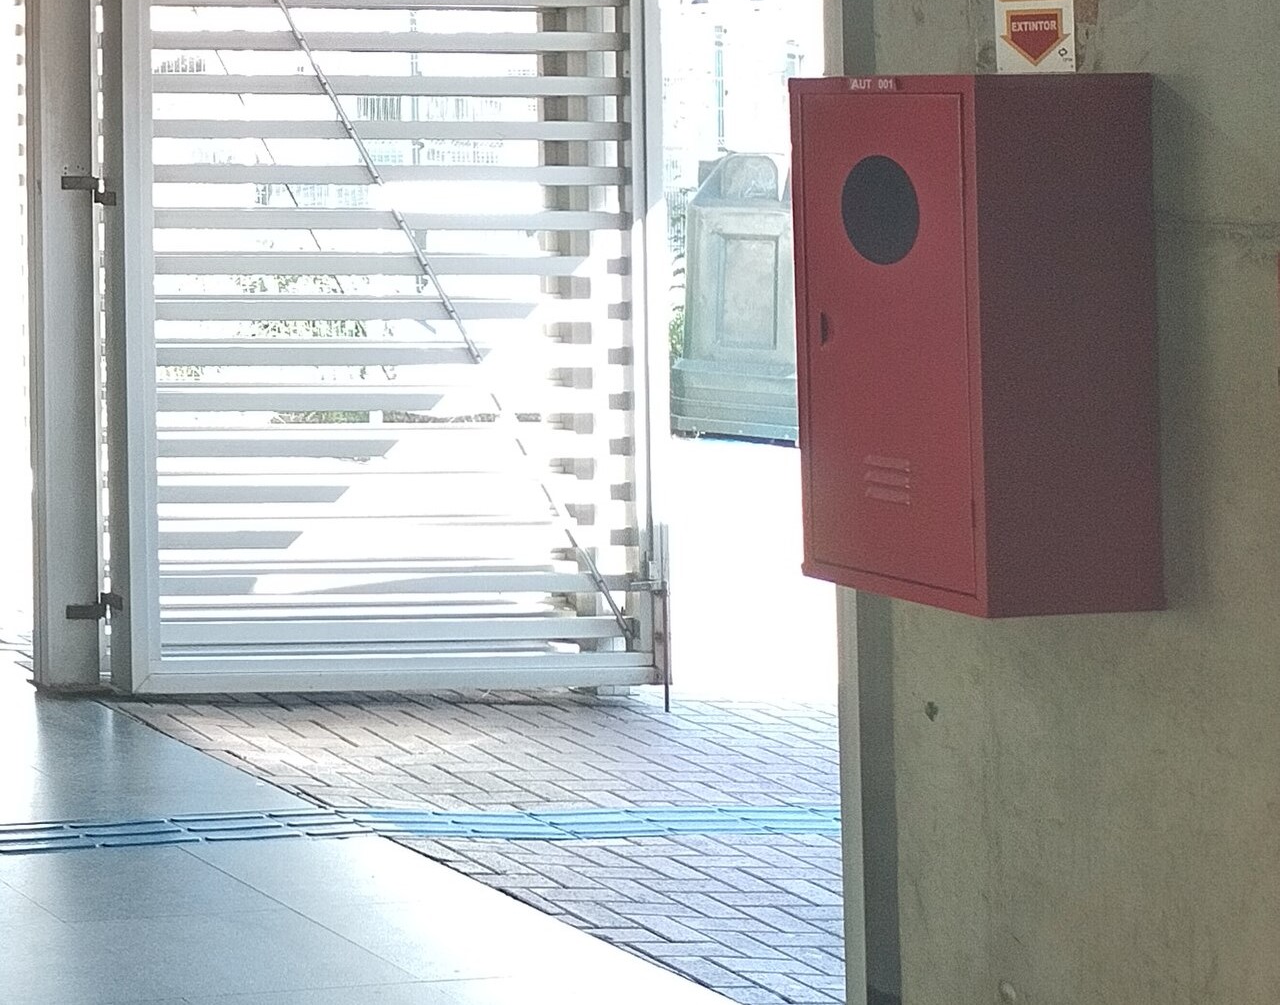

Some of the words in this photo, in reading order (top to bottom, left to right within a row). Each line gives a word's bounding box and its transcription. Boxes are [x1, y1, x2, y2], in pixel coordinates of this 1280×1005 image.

[1011, 20, 1057, 32] EXTINTOR
[850, 78, 872, 91] AUT
[878, 78, 893, 89] 001
